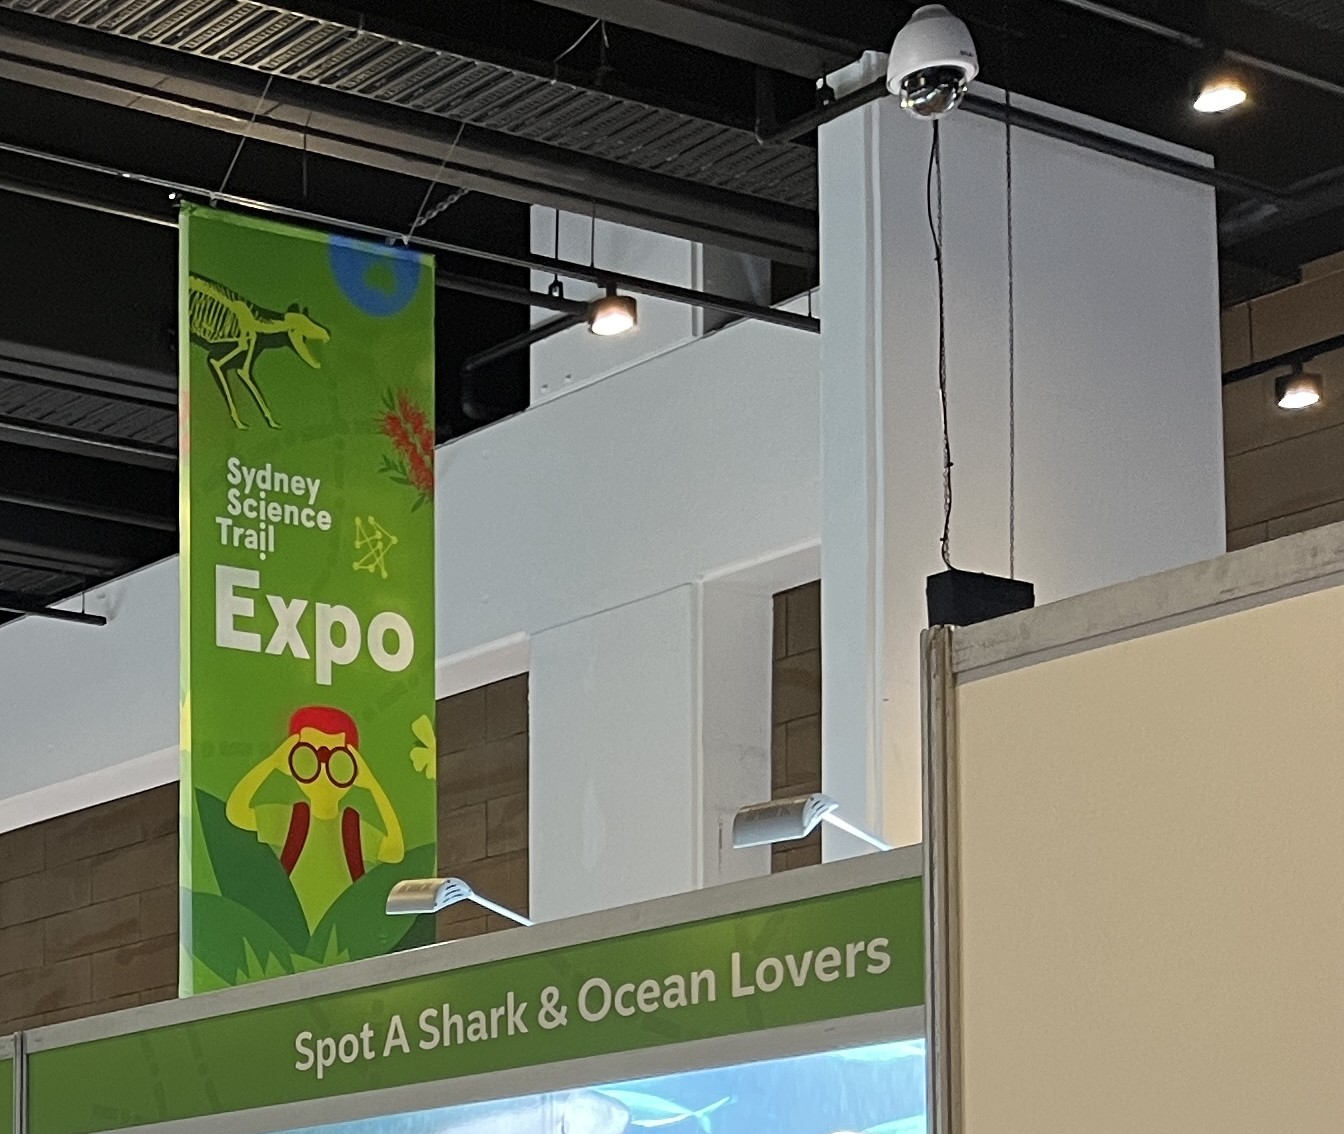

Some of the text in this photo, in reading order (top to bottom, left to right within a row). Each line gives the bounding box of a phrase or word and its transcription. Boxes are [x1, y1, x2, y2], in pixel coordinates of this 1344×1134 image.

[227, 457, 321, 505] Sydney
[227, 488, 332, 531] Science
[215, 517, 274, 561] Trail
[215, 564, 415, 686] Expo
[294, 936, 892, 1079] Spot A Shark & Ocean Lovers
